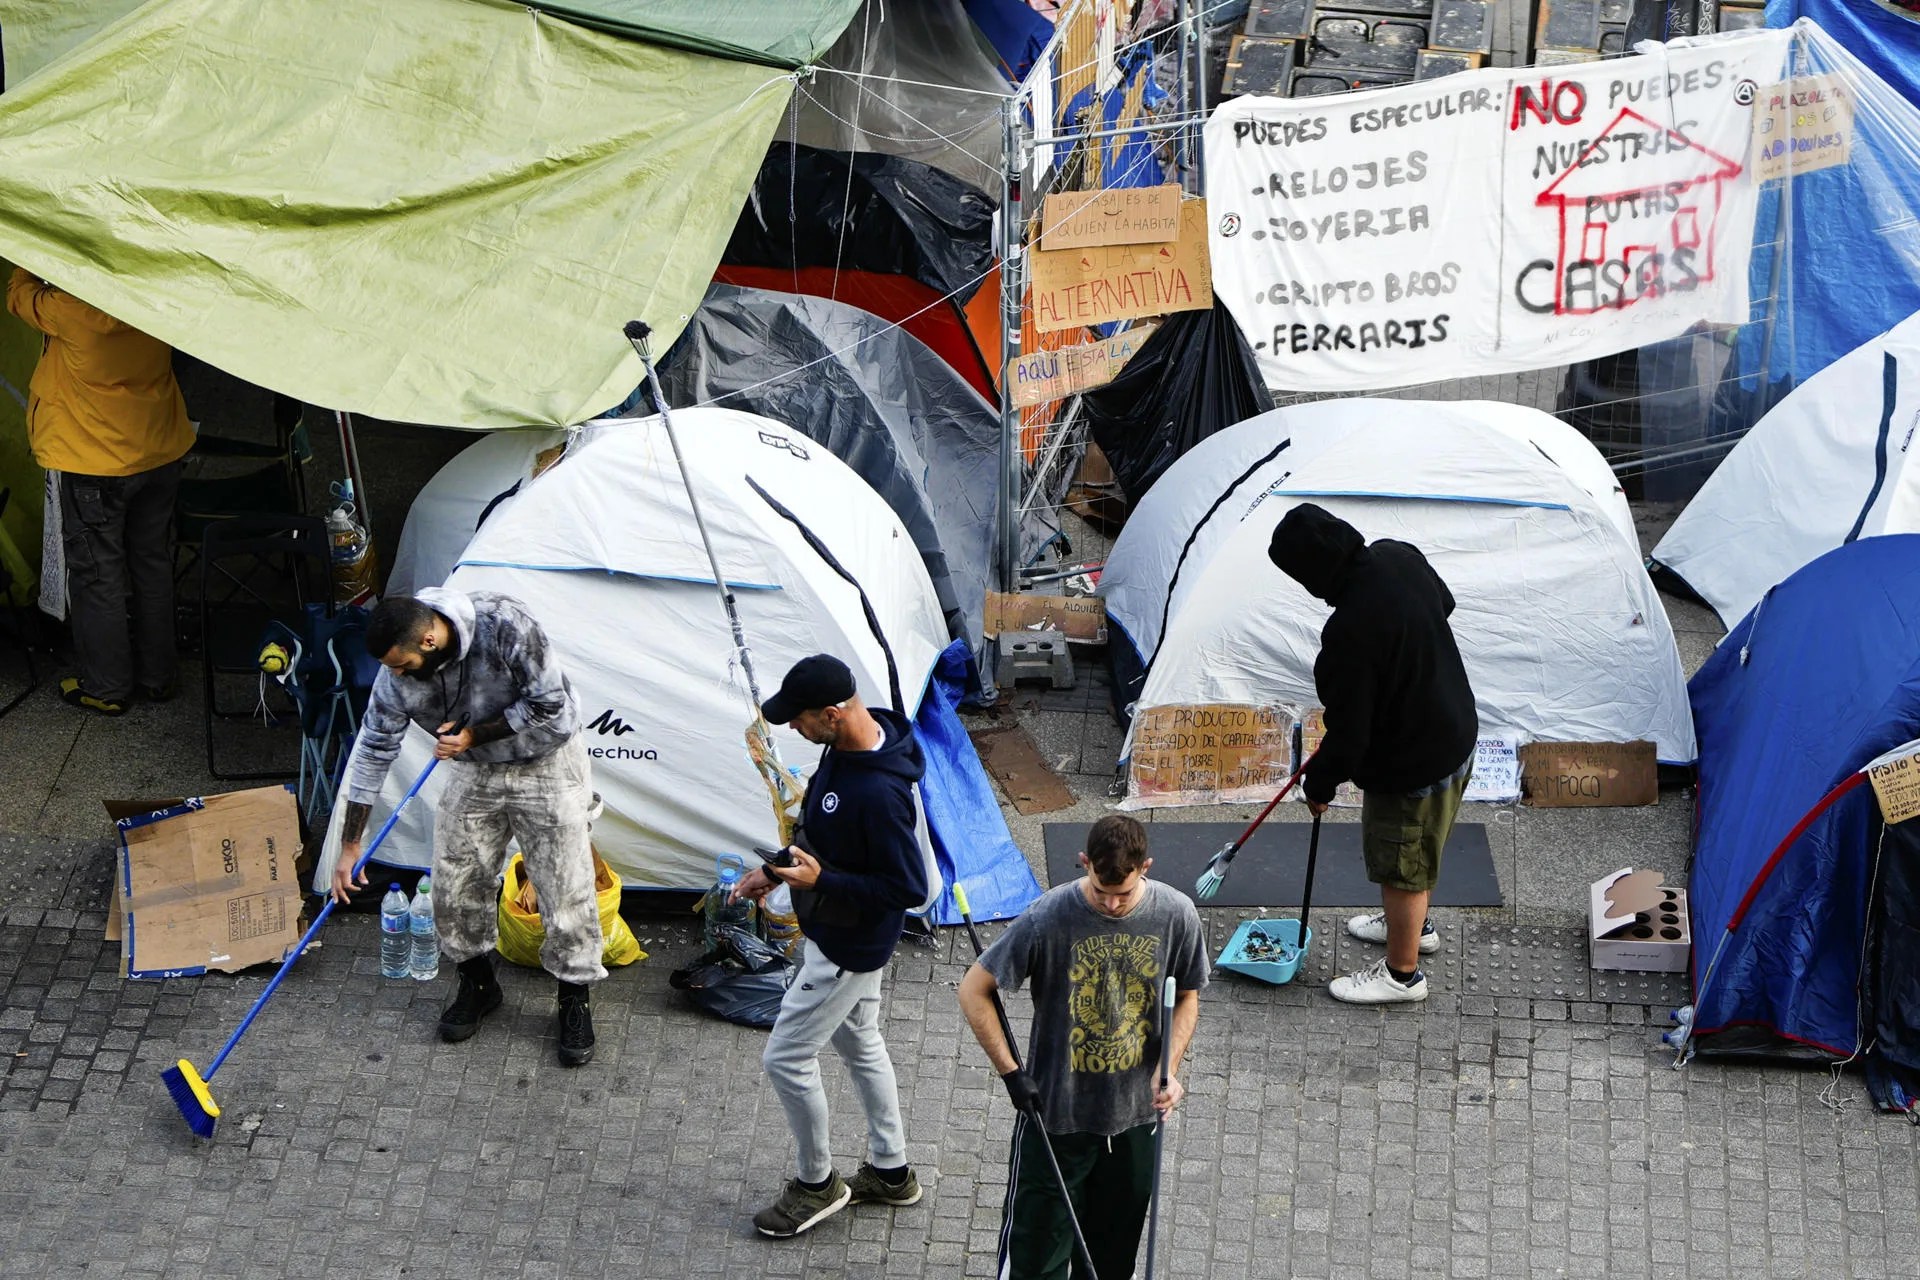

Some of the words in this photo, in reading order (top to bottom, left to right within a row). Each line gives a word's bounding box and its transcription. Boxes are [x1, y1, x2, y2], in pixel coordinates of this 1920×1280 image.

[1234, 116, 1328, 148] PUEDES
[1350, 88, 1503, 133] ESPECULAR:
[1510, 78, 1588, 130] NO
[1532, 120, 1698, 179] NUESTRAS
[1058, 197, 1074, 212] LA
[1083, 193, 1117, 209] CASA
[1126, 193, 1141, 206] ES
[1147, 192, 1160, 205] DE
[1585, 181, 1684, 223] PUTAS
[1057, 220, 1108, 237] QUIEN
[1114, 217, 1130, 231] LA
[1134, 217, 1176, 231] HABITA
[1040, 266, 1192, 324] ALTERNATIVA
[1385, 262, 1461, 303] BROS
[1514, 248, 1701, 313] CASAS
[1017, 353, 1060, 384] AQUÍ
[1110, 339, 1131, 359] LA
[1174, 709, 1248, 729] PRODUCTO
[588, 746, 658, 760] echua
[1202, 733, 1218, 748] DEL
[1222, 731, 1282, 747] CAPITALISMO
[1160, 757, 1174, 769] EL
[1182, 754, 1215, 768] POBRE
[1524, 775, 1600, 798] TAMPOCO
[1077, 935, 1112, 961] RIDE
[1114, 932, 1130, 946] OR
[1080, 995, 1092, 1007] 19
[1127, 992, 1142, 1003] 69
